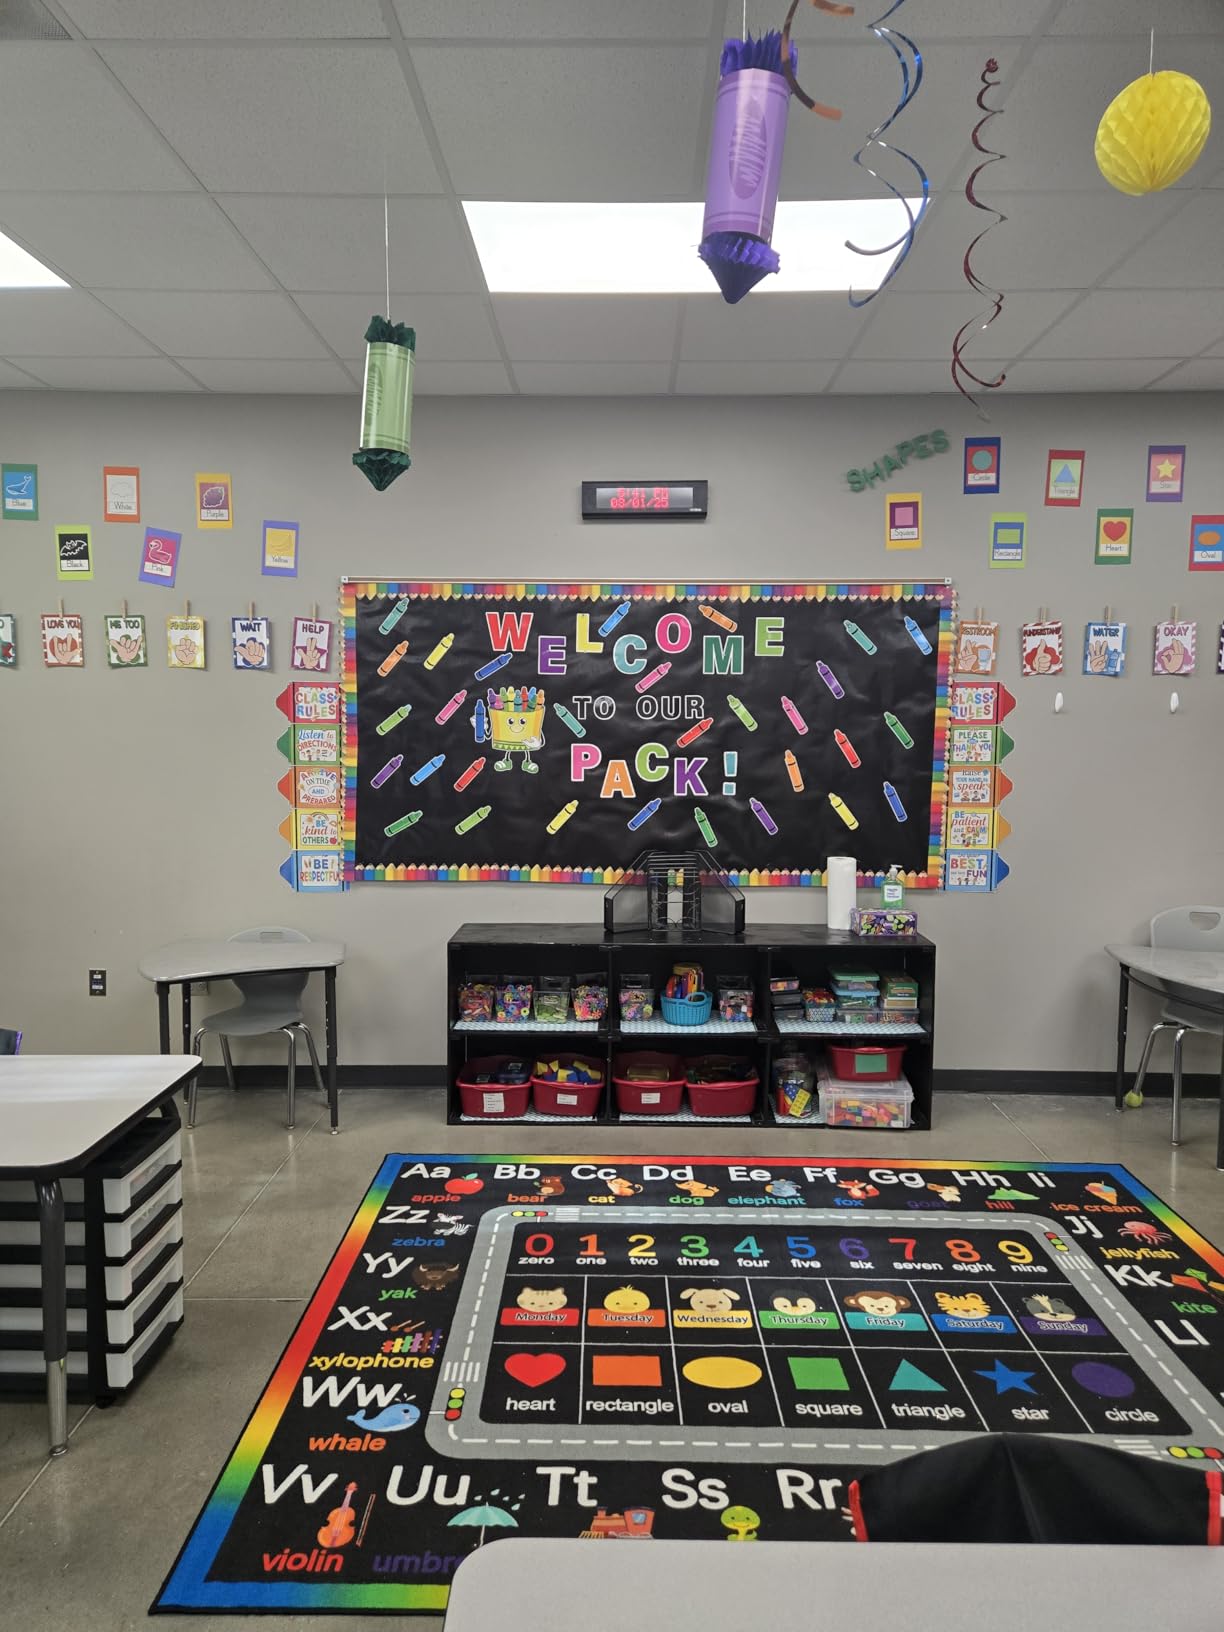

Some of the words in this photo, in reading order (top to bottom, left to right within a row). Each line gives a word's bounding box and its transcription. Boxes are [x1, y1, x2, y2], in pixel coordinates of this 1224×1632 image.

[846, 429, 949, 493] SHAPES
[1105, 544, 1123, 552] Heart
[1200, 550, 1216, 559] Oval
[270, 556, 289, 565] Yellow
[47, 619, 65, 630] LOVE
[66, 619, 80, 630] YOU
[110, 619, 123, 629] ME
[124, 619, 140, 629] TOO
[240, 622, 262, 633] WAIT
[302, 623, 325, 635] HELP
[1093, 628, 1119, 637] WATER
[1164, 627, 1189, 637] OKAY
[486, 611, 785, 675] WELCOME
[295, 692, 335, 704] CLASS
[952, 692, 991, 704] CLASS
[296, 704, 336, 717] RULES
[573, 696, 616, 720] TO
[636, 695, 705, 720] OUR
[951, 704, 991, 718] RULES
[958, 731, 988, 739] PLEASE
[297, 739, 337, 752] DIRECTIONS
[952, 743, 977, 752] THANK
[571, 742, 738, 799] PACK!
[957, 781, 986, 793] speak
[302, 793, 336, 805] PREPARED
[952, 815, 987, 828] patient
[955, 811, 966, 819] BE
[305, 825, 328, 835] kind
[966, 826, 987, 834] CALM
[302, 836, 329, 844] OTHERS
[314, 859, 329, 869] BE
[951, 858, 984, 869] BEST
[300, 871, 341, 882] RESPECTFU
[966, 870, 987, 878] FUN
[400, 1162, 452, 1179] Aa
[493, 1163, 541, 1180] Bb
[571, 1164, 617, 1181] Cc
[642, 1165, 695, 1181] Dd
[727, 1166, 772, 1182] Ee
[803, 1167, 839, 1183] Ff
[868, 1168, 926, 1188] Gg
[952, 1171, 1012, 1187] Hh
[1027, 1172, 1057, 1188] Ii
[411, 1194, 461, 1204] apple
[507, 1193, 548, 1203] bear
[588, 1194, 616, 1204] cat
[668, 1194, 705, 1206] dog
[727, 1195, 807, 1206] elephant
[833, 1197, 864, 1207] fox
[985, 1200, 1016, 1210] hill
[1051, 1202, 1079, 1212] ice
[1083, 1203, 1143, 1214] cream
[378, 1205, 430, 1224] Zz
[1064, 1215, 1104, 1239] Jj
[391, 1236, 446, 1247] zebra
[525, 1233, 554, 1257] 0
[579, 1233, 605, 1257] 1
[627, 1234, 657, 1257] 2
[680, 1234, 710, 1258] 3
[733, 1235, 764, 1258] 4
[786, 1236, 817, 1259] 5
[839, 1238, 870, 1260] 6
[888, 1238, 917, 1261] 7
[945, 1239, 981, 1263] 8
[998, 1240, 1034, 1264] 9
[1100, 1246, 1180, 1261] jellyfish
[362, 1252, 414, 1279] Yy
[518, 1256, 555, 1265] zero
[575, 1256, 606, 1265] one
[629, 1256, 659, 1266] two
[677, 1256, 720, 1266] three
[737, 1257, 770, 1268] four
[790, 1258, 822, 1269] five
[850, 1259, 875, 1270] six
[893, 1261, 944, 1271] seven
[952, 1262, 996, 1273] eight
[1011, 1263, 1048, 1274] nine
[1104, 1264, 1174, 1287] Kk
[378, 1287, 417, 1301] yak
[1173, 1301, 1218, 1314] kite
[327, 1305, 392, 1331] Xx
[515, 1312, 567, 1323] Monday
[602, 1312, 653, 1324] Tuesday
[677, 1314, 748, 1325] Wednesday
[770, 1314, 827, 1326] Thursday
[866, 1316, 906, 1329] Friday
[946, 1318, 1003, 1331] Saturday
[1038, 1321, 1088, 1333] Sunday
[308, 1352, 434, 1372] xylophone
[302, 1375, 403, 1408] Ww
[505, 1397, 556, 1412] heart
[585, 1398, 674, 1415] rectangle
[708, 1400, 748, 1414] oval
[795, 1401, 863, 1417] square
[891, 1402, 966, 1421] triangle
[1011, 1406, 1050, 1421] star
[1105, 1407, 1160, 1423] circle
[308, 1433, 387, 1452] whale
[262, 1464, 339, 1504] Vv
[386, 1465, 471, 1506] Uu
[535, 1466, 598, 1507] Tt
[661, 1467, 730, 1510] Ss
[776, 1468, 842, 1510] Rr
[262, 1549, 344, 1573] violin
